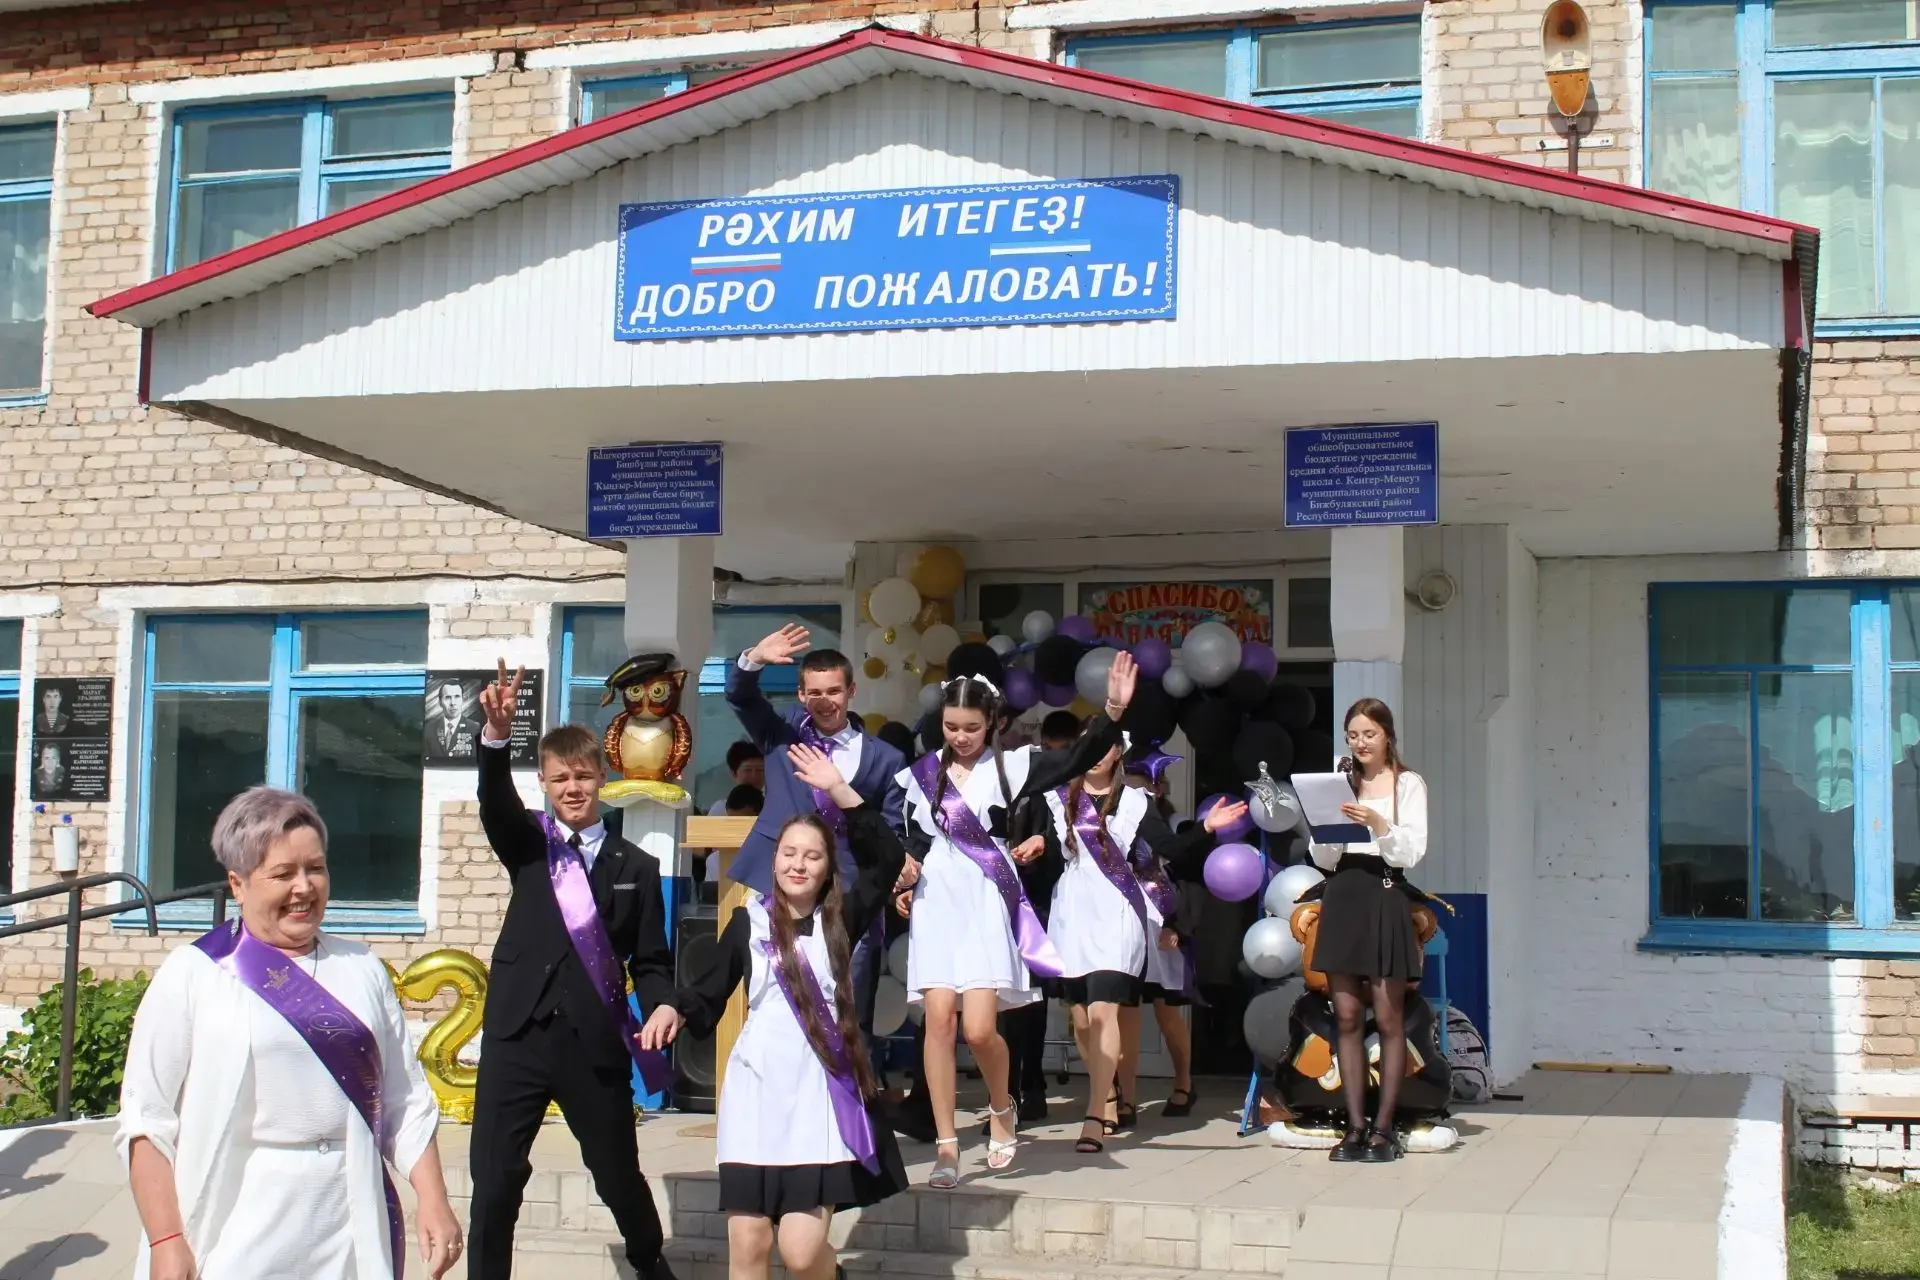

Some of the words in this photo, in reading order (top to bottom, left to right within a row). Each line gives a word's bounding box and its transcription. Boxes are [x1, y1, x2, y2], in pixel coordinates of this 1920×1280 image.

[698, 207, 854, 248] РӘХИМ
[897, 196, 1086, 238] ИТЕГЕҘ!
[628, 278, 776, 326] ДОБРО
[813, 262, 1158, 310] ПОЖАЛОВАТЬ!
[1322, 432, 1400, 442] Муниципальное
[1307, 441, 1414, 452] общеобразовательное
[660, 459, 693, 469] районы
[1304, 454, 1358, 464] бюджетное
[1360, 452, 1417, 463] учреждение
[611, 470, 663, 480] муниципаль
[664, 469, 698, 479] районы
[1290, 467, 1326, 476] средняя
[1328, 464, 1432, 475] общеобразовательная
[1302, 478, 1333, 487] школа
[1346, 475, 1420, 486] Кенгер-Менеуз
[603, 494, 622, 502] урта
[652, 490, 678, 499] белем
[1301, 488, 1382, 499] муниципального
[1385, 486, 1420, 496] района
[627, 501, 680, 512] муниципаль
[681, 500, 715, 509] бюджет
[1310, 498, 1380, 510] Бижбулякский
[1382, 498, 1412, 508] район
[655, 512, 680, 520] белем
[1296, 511, 1352, 522] Республики
[1355, 509, 1426, 520] Башкортостан
[636, 521, 698, 532] учреждениеһы
